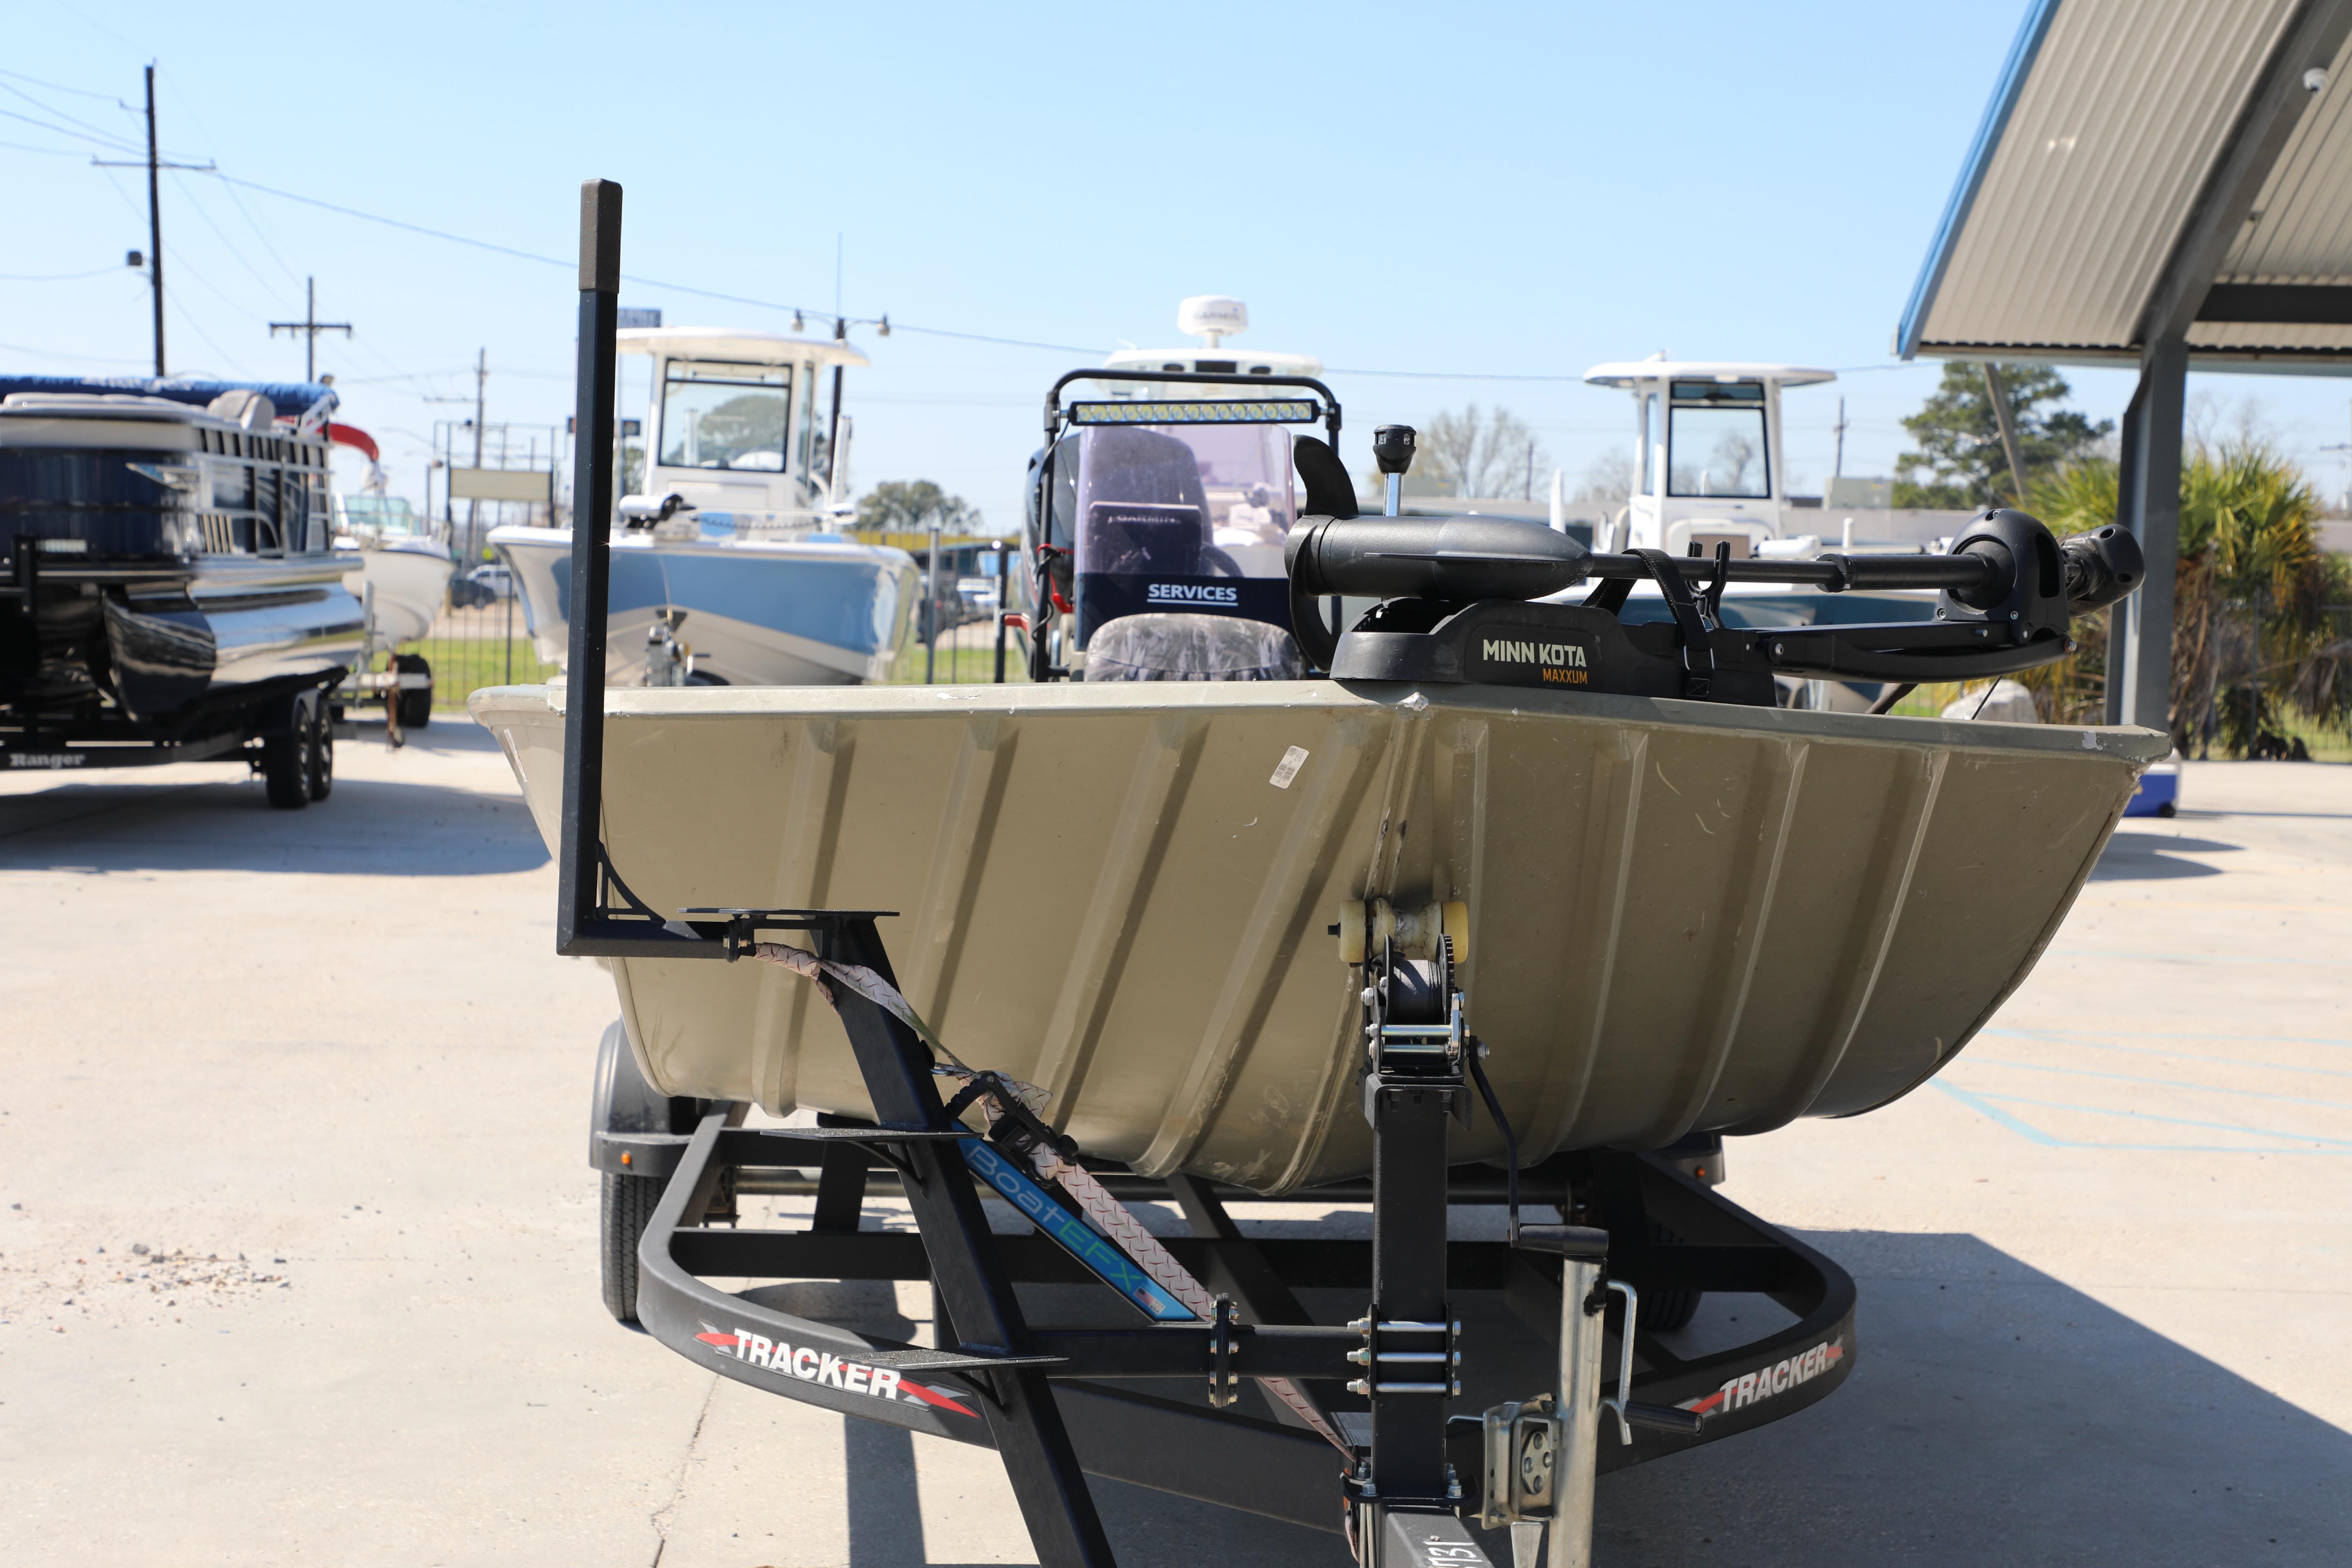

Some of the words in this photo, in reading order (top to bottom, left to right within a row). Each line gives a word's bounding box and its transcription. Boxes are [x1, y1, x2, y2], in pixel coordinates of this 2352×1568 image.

[1148, 584, 1237, 601] SERVICES
[1483, 639, 1535, 663] MINN
[1539, 643, 1587, 667] KOTA
[1543, 668, 1588, 685] MAXXUM
[9, 753, 85, 769] Ranger
[734, 1328, 901, 1401] TRACKER
[1719, 1342, 1828, 1413] TRACKER
